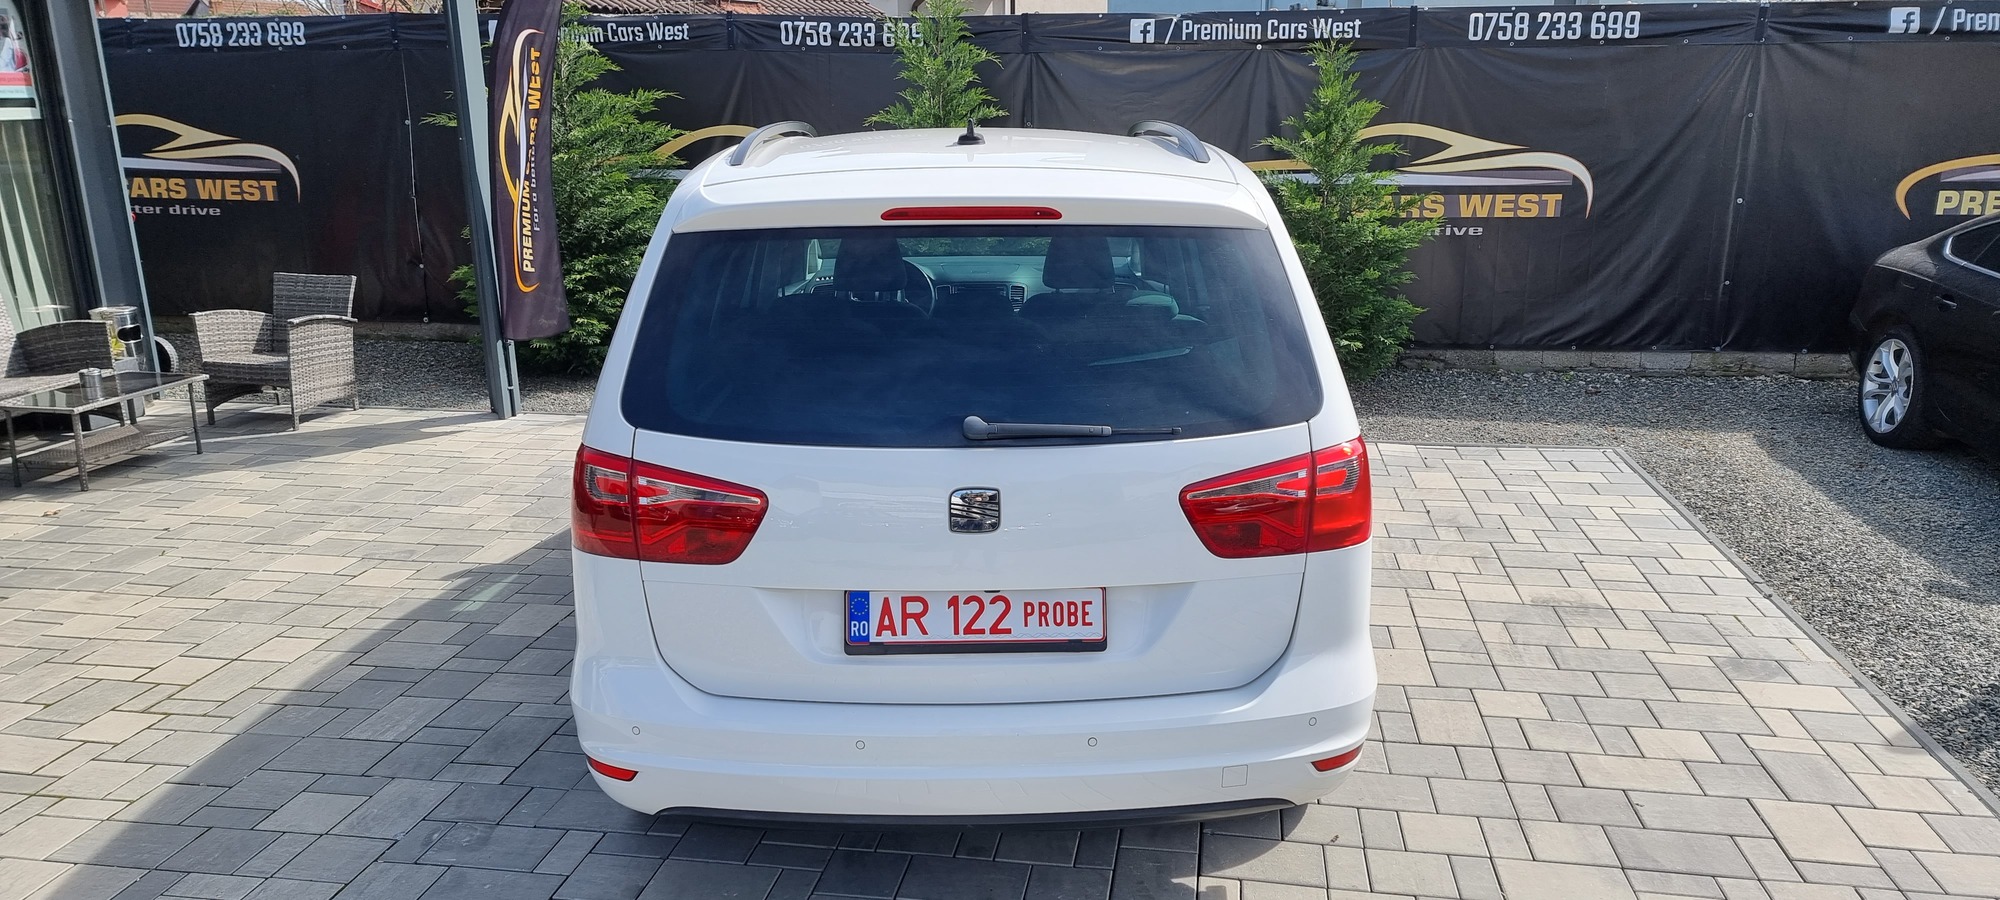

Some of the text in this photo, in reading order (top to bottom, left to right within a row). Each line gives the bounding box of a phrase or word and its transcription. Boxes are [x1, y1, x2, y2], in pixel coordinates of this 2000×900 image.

[175, 21, 306, 47] 0758 233 699
[608, 22, 643, 42] Cars
[644, 22, 689, 41] West
[780, 21, 832, 46] 0758
[838, 22, 876, 47] 233
[1182, 18, 1262, 41] Premium
[1267, 19, 1308, 40] Cars
[1312, 18, 1361, 39] West
[1468, 11, 1641, 41] 0758 233 699
[528, 47, 541, 110] WEST
[126, 177, 277, 201] ARS WEST
[532, 193, 538, 202] a
[169, 204, 221, 216] drive
[1459, 193, 1563, 218] WEST
[522, 181, 536, 273] PREMIUM
[875, 594, 1093, 637] AR 122 PROBE
[851, 620, 868, 637] RO
